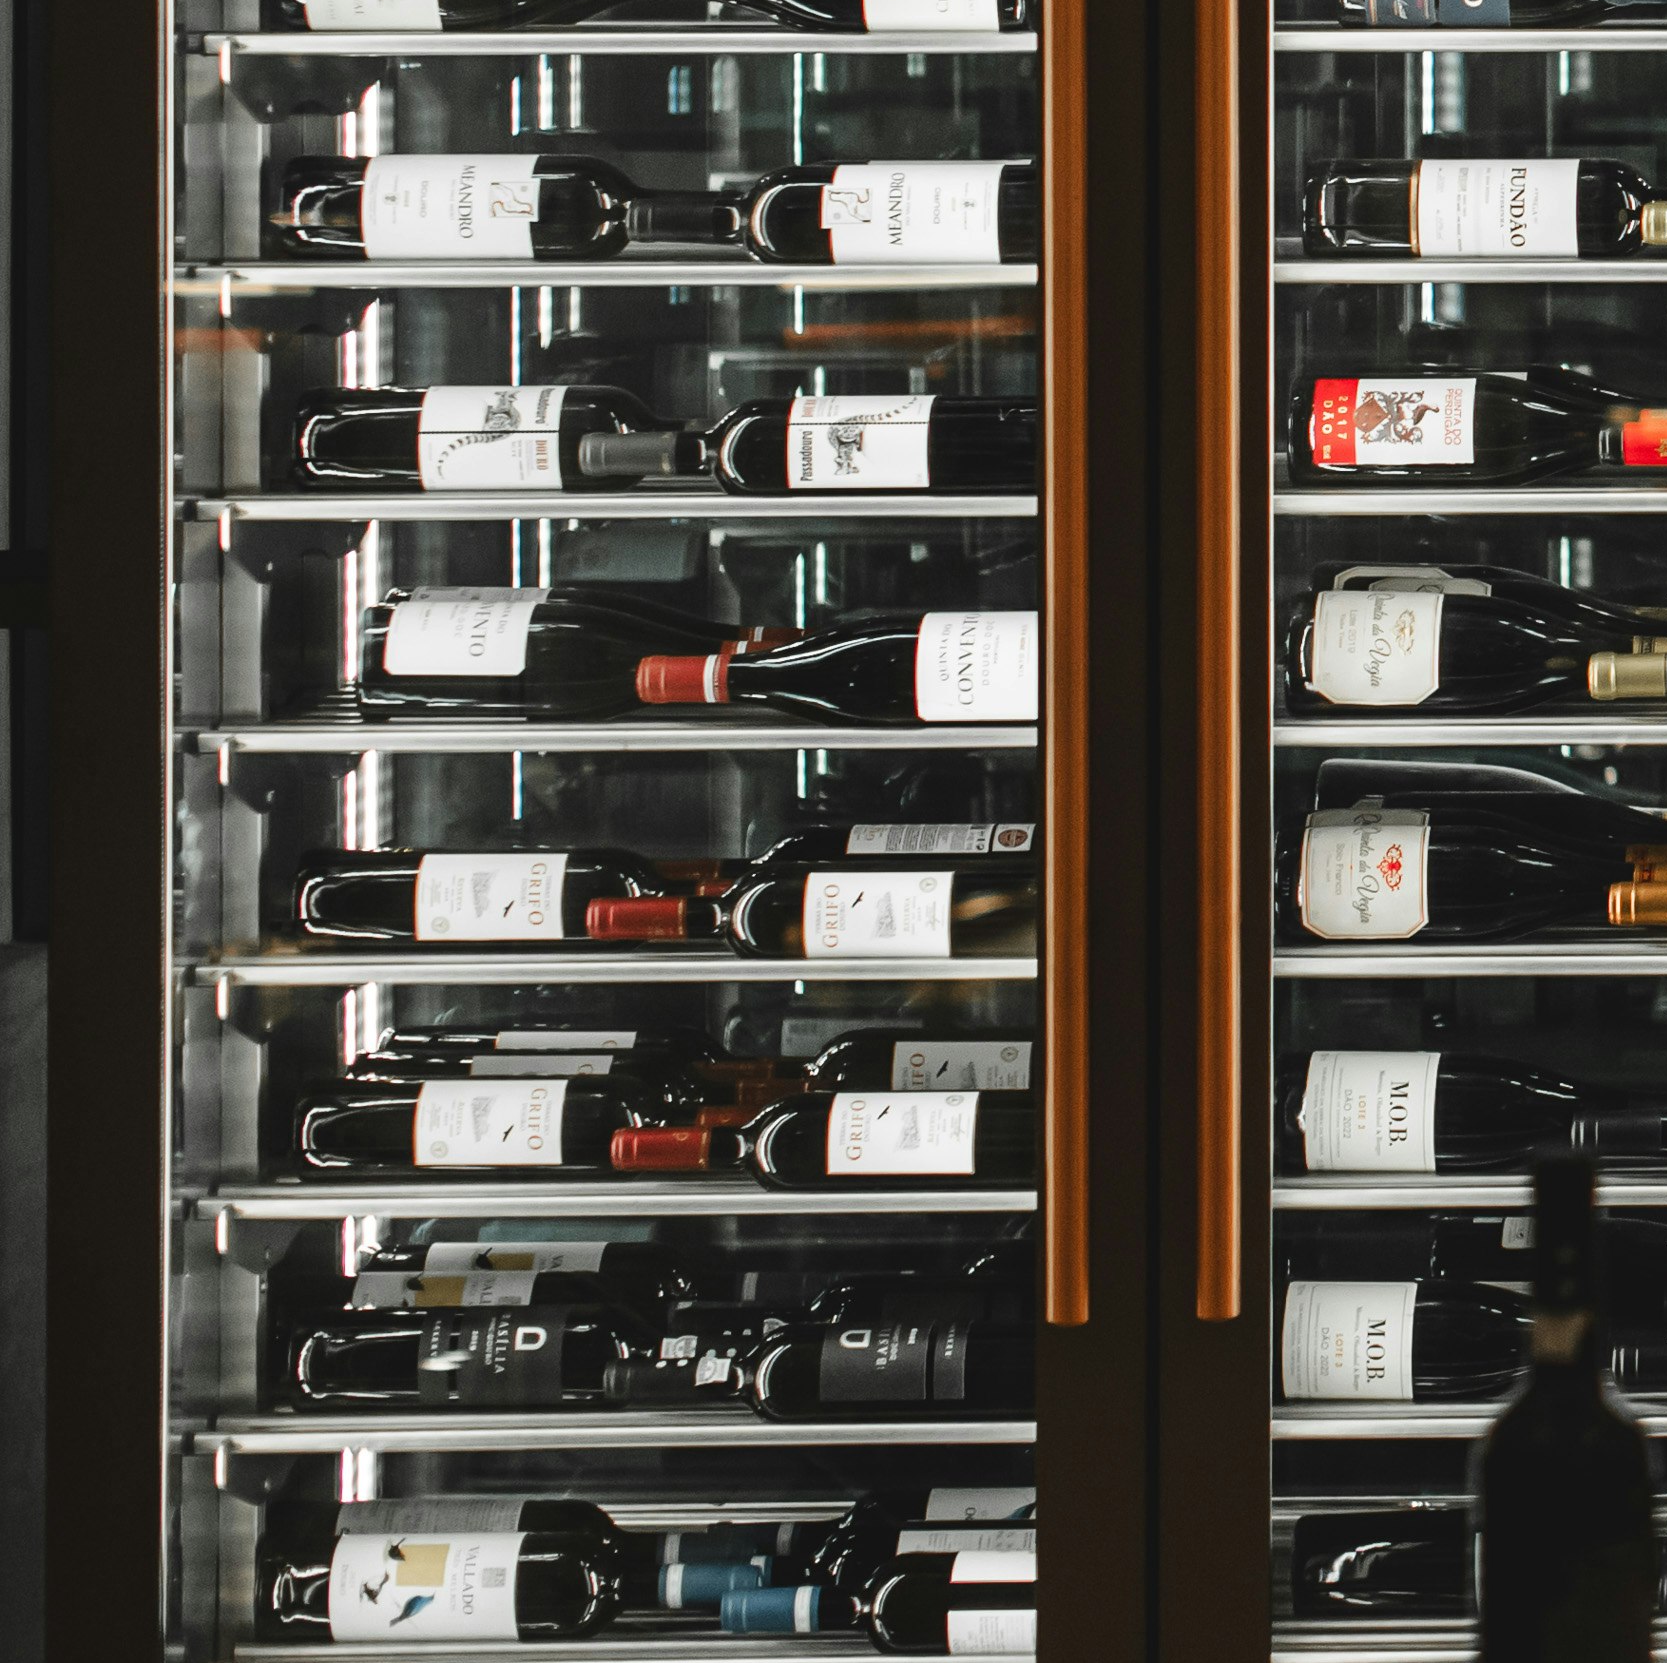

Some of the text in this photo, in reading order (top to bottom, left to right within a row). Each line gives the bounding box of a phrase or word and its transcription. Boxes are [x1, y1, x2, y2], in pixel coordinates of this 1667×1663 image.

[419, 180, 430, 219] DOURO
[457, 163, 477, 239] MEANDRO
[887, 172, 905, 247] MEANDRO
[932, 187, 943, 225] DOURO
[1508, 166, 1528, 248] FUNDÃO
[1321, 400, 1335, 435] DÃO
[1337, 396, 1349, 439] 2017
[1443, 387, 1455, 446] PERDIGÃO
[1452, 388, 1463, 446] QUINTA DO
[799, 430, 814, 482] Passadouro
[938, 623, 952, 683] QUINTA DO
[981, 642, 992, 687] DOURO
[1363, 623, 1392, 688] da Vegia
[527, 861, 548, 927] GRIFO
[820, 883, 840, 949] GRIFO
[1351, 859, 1380, 924] da Vegia
[527, 1087, 549, 1151] GRIFO
[845, 1100, 868, 1162] GRIFO
[1344, 1088, 1356, 1140] DÃO 2022
[1358, 1094, 1367, 1121] LOTE
[1388, 1080, 1410, 1147] M.O.B.
[1320, 1326, 1333, 1352] DÃO
[1334, 1332, 1345, 1360] LOTE
[1366, 1317, 1387, 1385] M.O.B.
[463, 1544, 482, 1616] VALLADO
